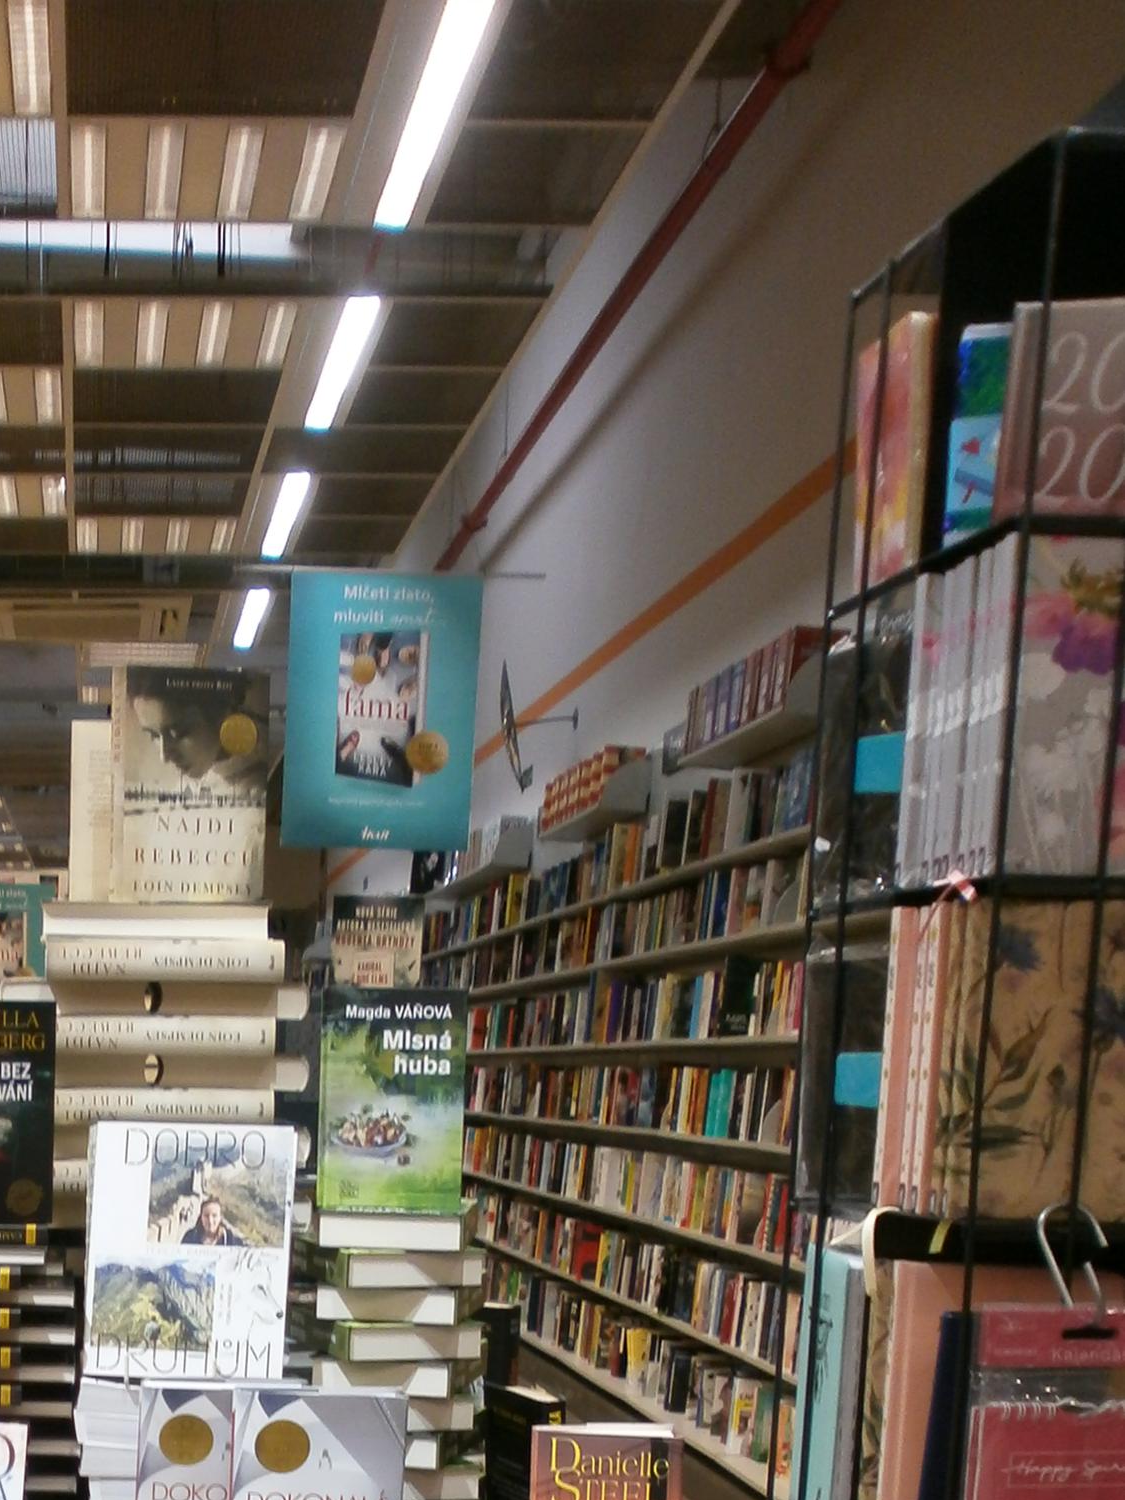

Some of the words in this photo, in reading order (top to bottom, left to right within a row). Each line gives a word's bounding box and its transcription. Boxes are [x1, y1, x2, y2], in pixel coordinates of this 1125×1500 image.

[344, 583, 389, 600] Mlčeti
[334, 610, 384, 625] mluviti
[345, 686, 409, 722] fáma
[157, 814, 235, 836] NAJDI
[134, 847, 258, 867] REBECCU
[133, 879, 173, 895] EOIN
[180, 879, 252, 897] DEMPSEY
[345, 1003, 391, 1022] Magda
[394, 1002, 453, 1020] VÁŇOVÁ
[383, 1027, 452, 1051] Mlsná
[1, 1062, 31, 1080] BEZ
[394, 1055, 451, 1076] huba
[125, 1128, 266, 1170] DOBRO
[550, 1436, 670, 1480] Danielle
